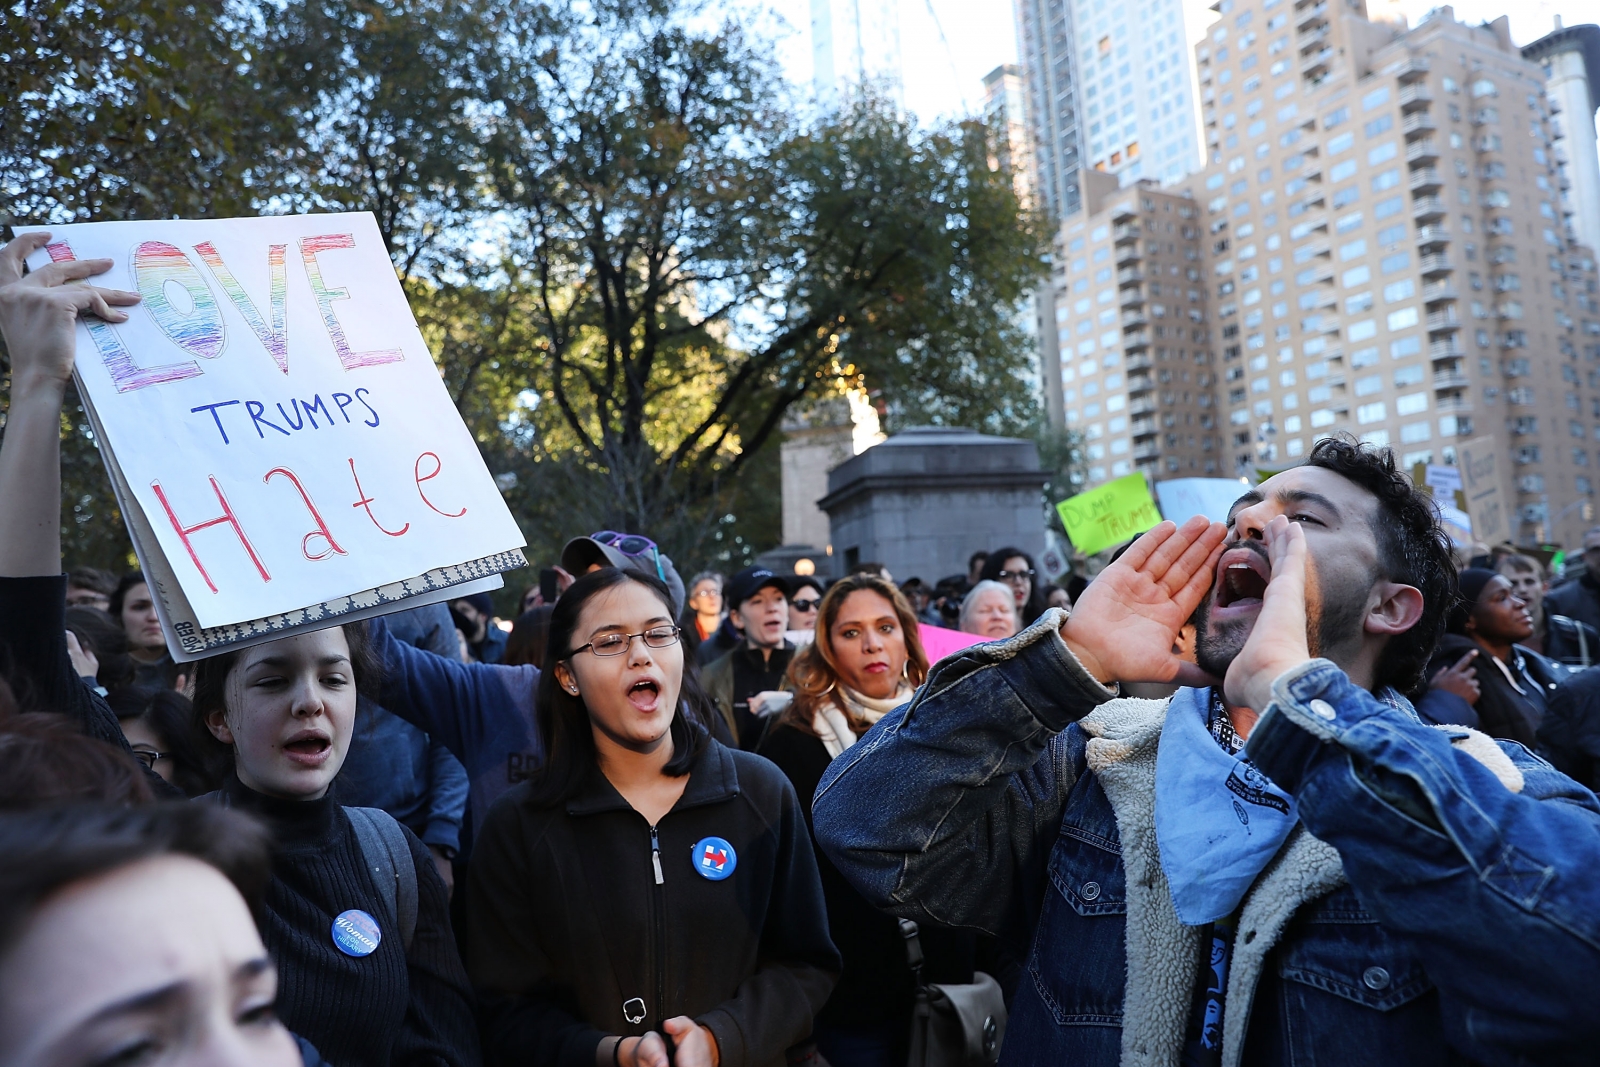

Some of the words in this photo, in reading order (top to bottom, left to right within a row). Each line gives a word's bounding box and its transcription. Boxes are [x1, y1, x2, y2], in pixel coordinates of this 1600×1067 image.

[44, 232, 405, 394] LOVE
[190, 387, 380, 444] TRUMPS
[149, 451, 468, 595] Hate
[1061, 492, 1115, 530] DUMP
[1096, 501, 1156, 541] TRUMP
[1226, 780, 1246, 797] ROAD
[1246, 794, 1260, 803] THE
[1260, 797, 1284, 809] MAKE
[336, 917, 377, 949] Woman
[337, 935, 363, 954] HILLARY
[347, 935, 360, 946] FOR
